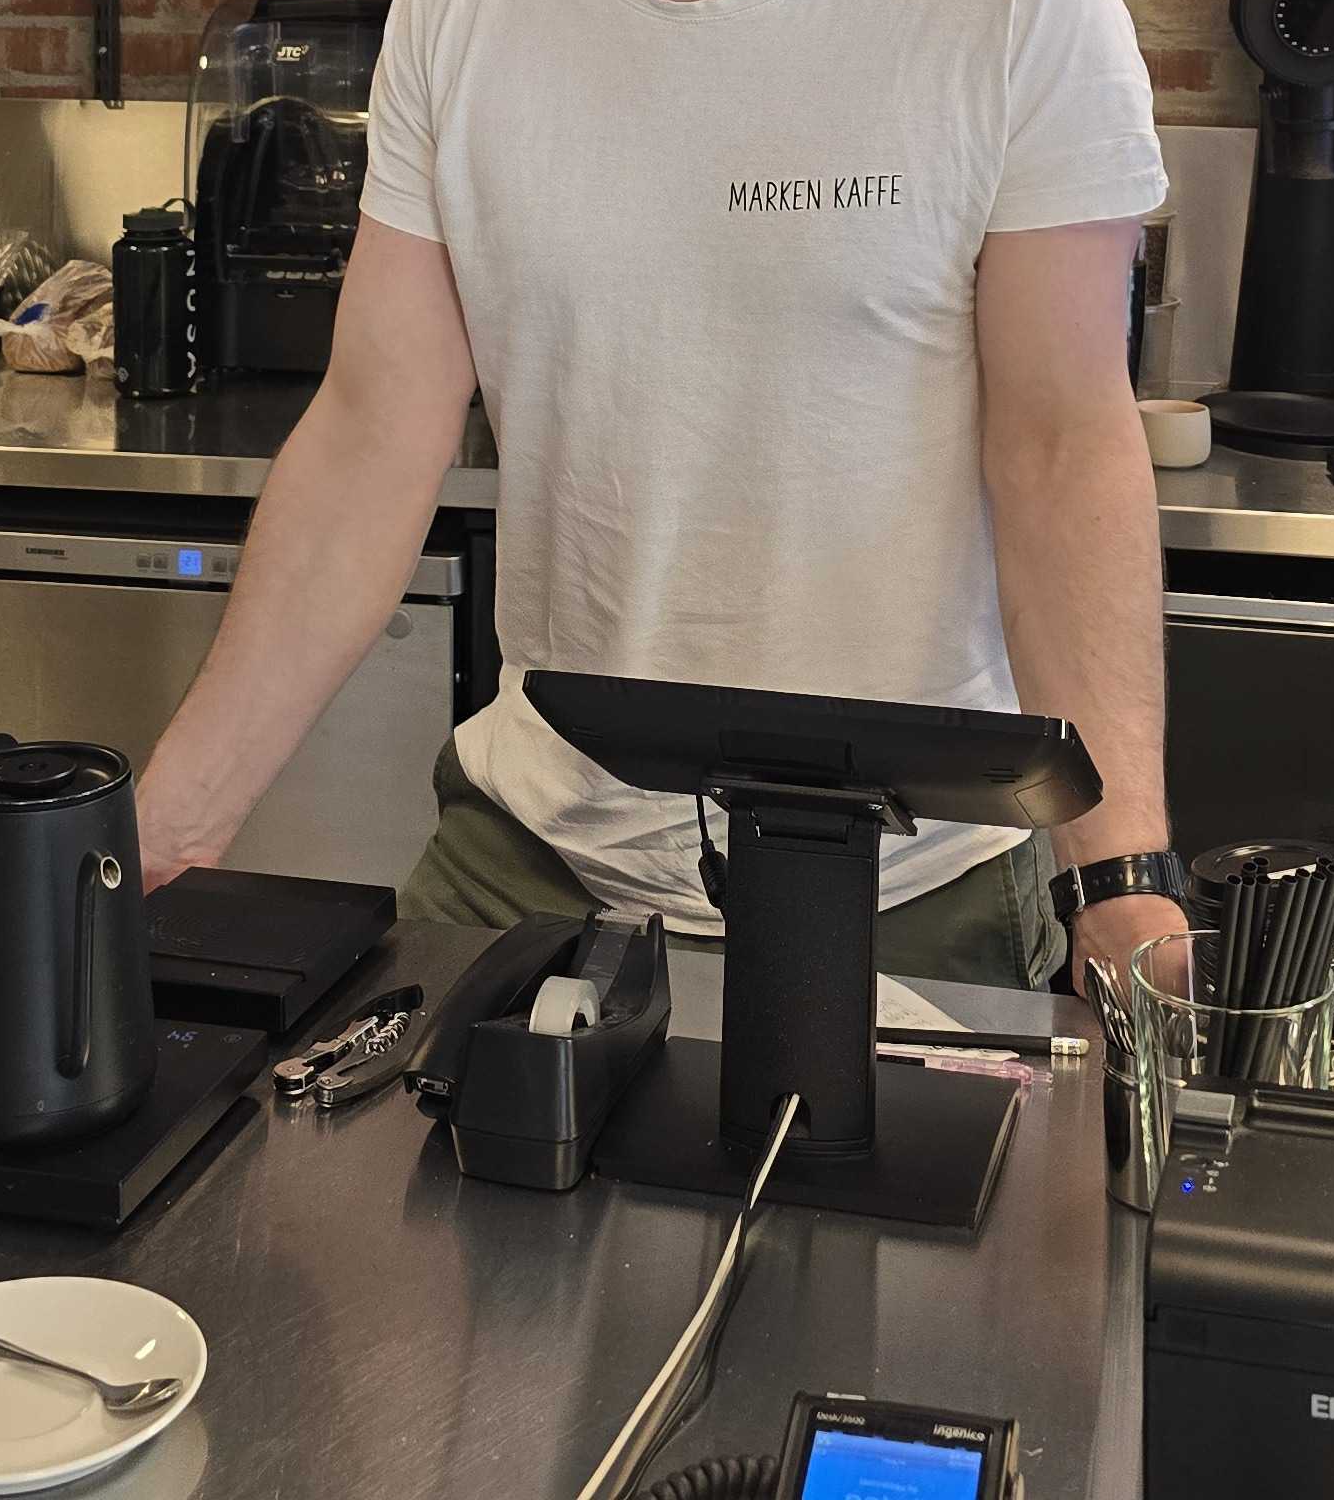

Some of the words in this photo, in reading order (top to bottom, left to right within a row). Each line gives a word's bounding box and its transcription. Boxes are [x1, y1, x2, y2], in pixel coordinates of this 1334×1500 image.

[277, 46, 301, 57] JTC
[728, 180, 821, 212] MARKEN
[833, 175, 903, 209] KAFFE
